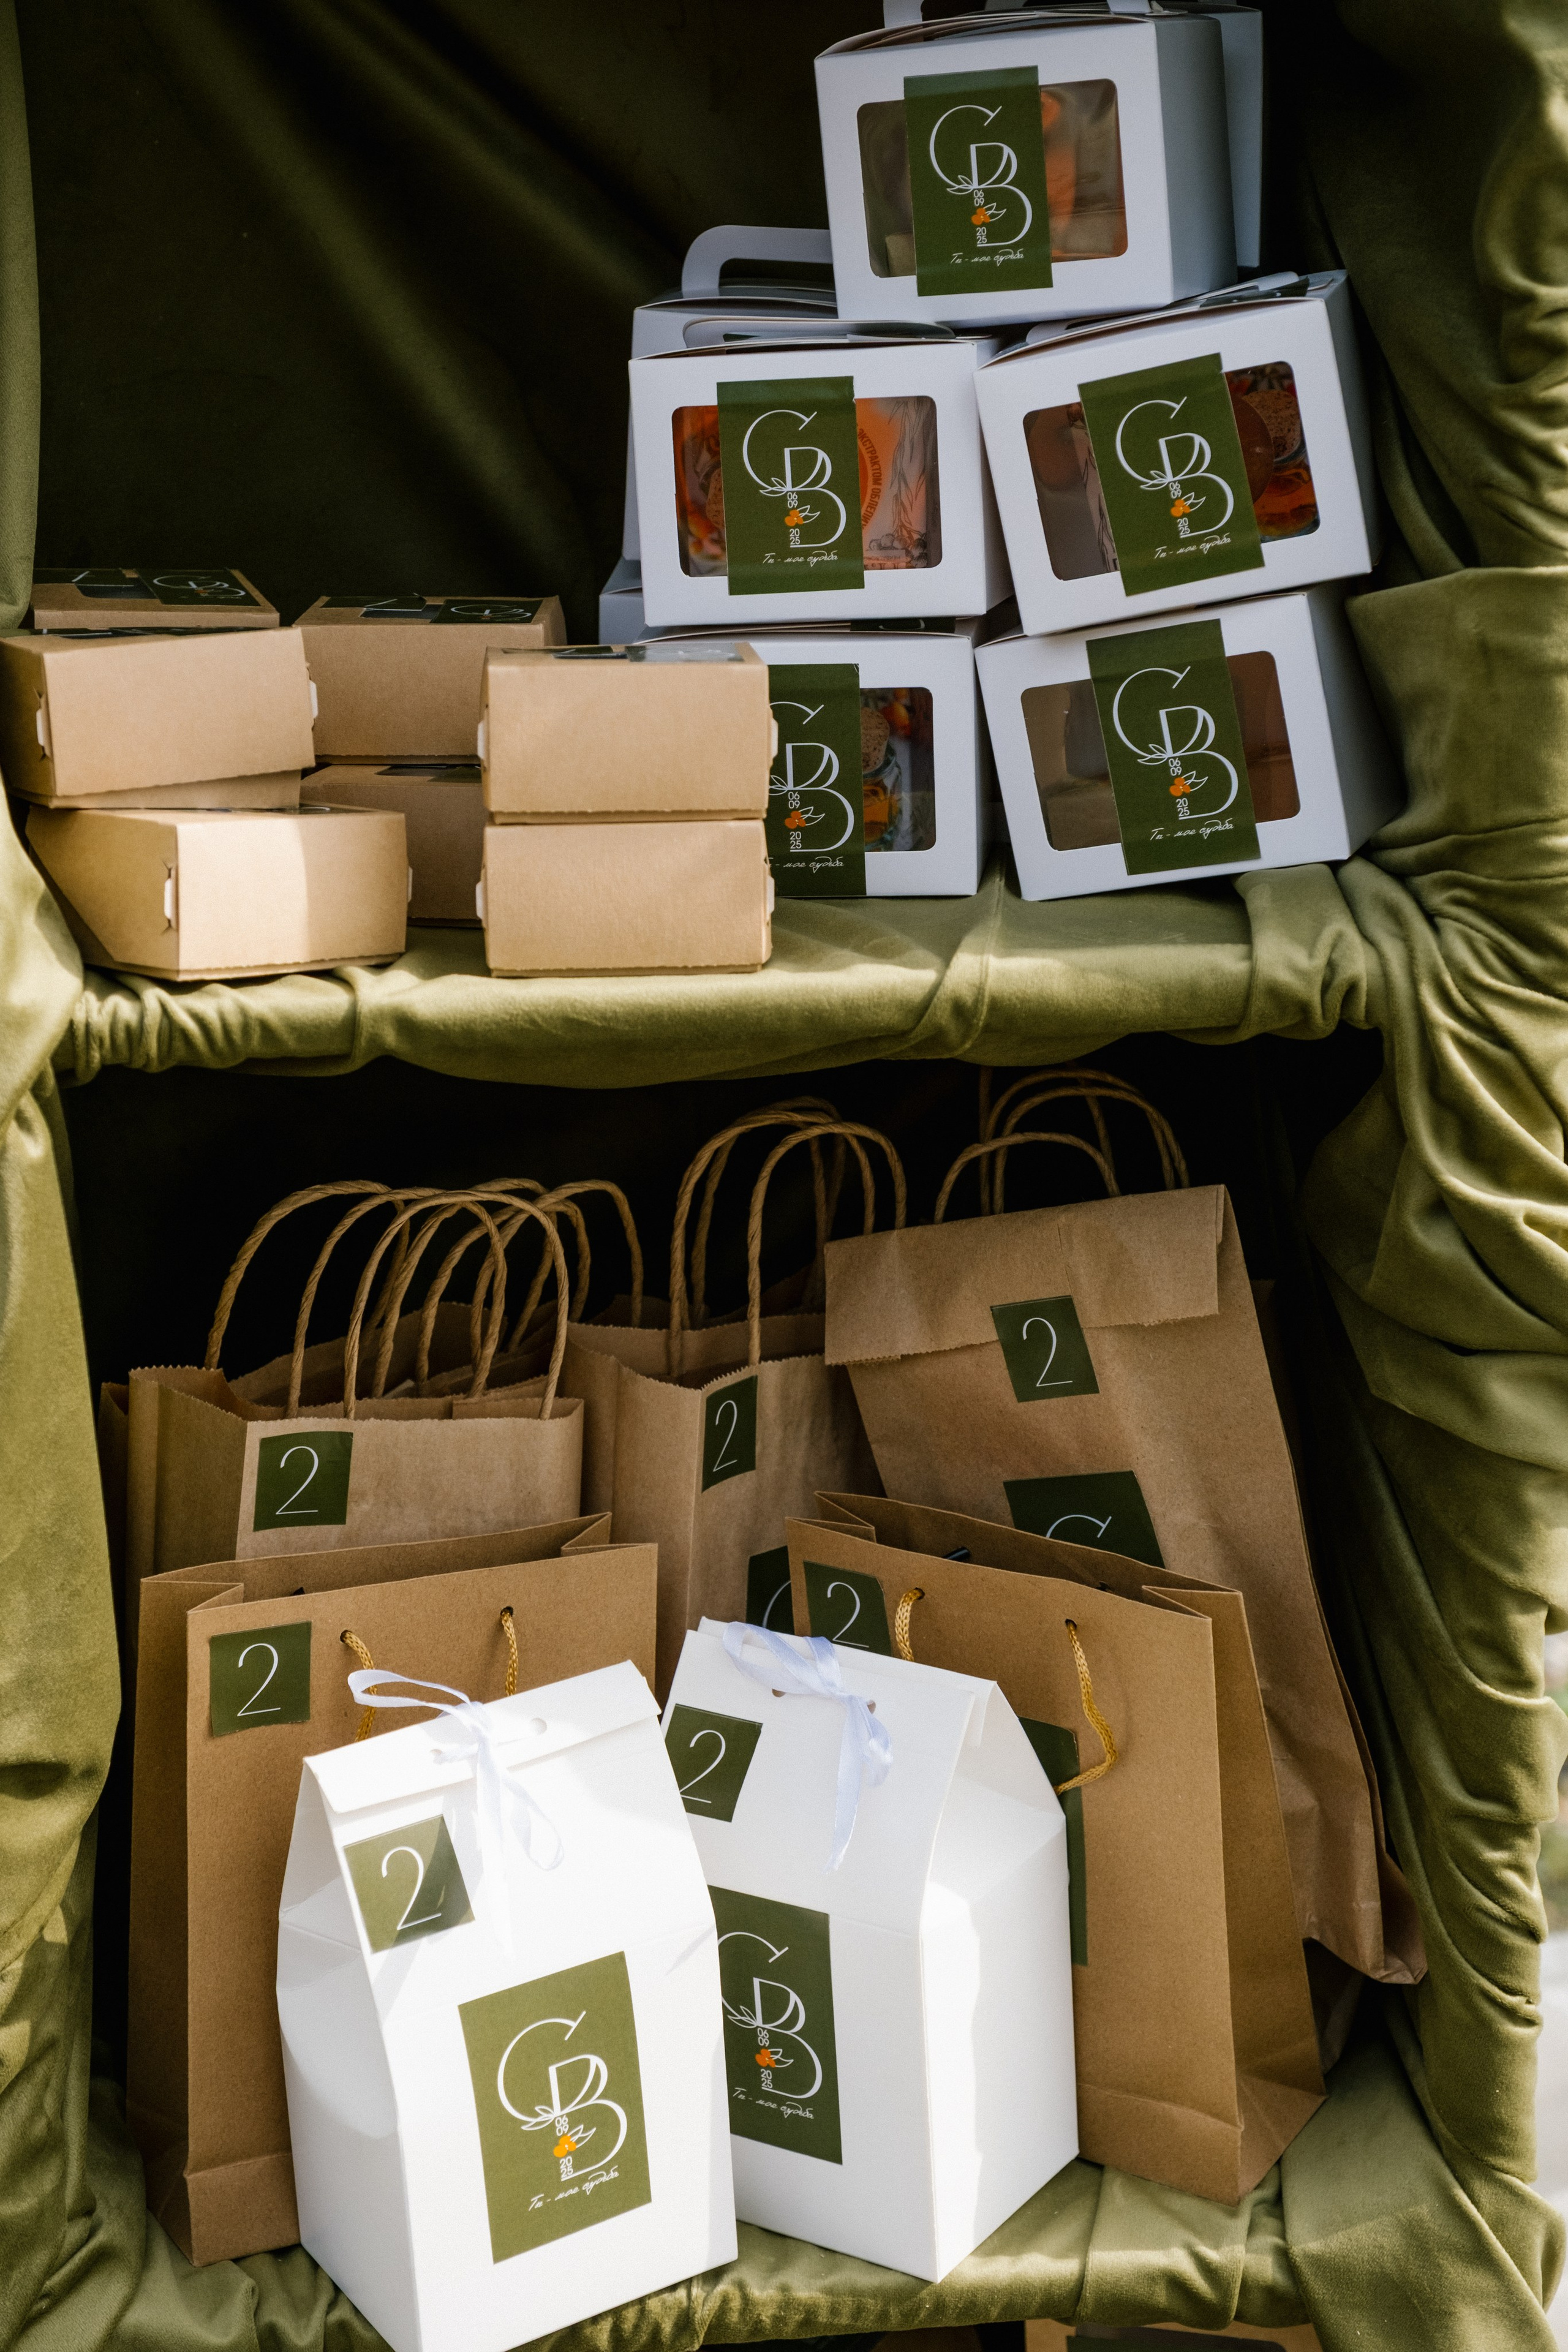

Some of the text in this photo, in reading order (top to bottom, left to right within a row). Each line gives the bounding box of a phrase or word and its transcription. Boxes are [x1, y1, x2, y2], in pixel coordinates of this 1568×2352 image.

[993, 249, 1024, 266] судьба
[1169, 481, 1180, 490] 06
[787, 492, 797, 500] 06
[1170, 489, 1182, 499] 09
[862, 488, 881, 529] ОБЛЕПИ
[1177, 518, 1188, 527] 20
[1179, 526, 1190, 535] 25
[1199, 532, 1231, 554] судьба
[807, 550, 839, 567] судьба
[1169, 758, 1181, 767] 06
[1170, 766, 1182, 776] 09
[788, 791, 800, 800] 06
[789, 800, 800, 809] 09
[1176, 797, 1188, 808] 20
[1177, 807, 1189, 817] 25
[1199, 818, 1234, 840] судьба
[790, 831, 801, 840] 20
[790, 840, 802, 849] 25
[809, 856, 845, 873] судьба
[1022, 1317, 1073, 1387] 2
[712, 1400, 737, 1473] 2
[275, 1445, 319, 1515] 2
[826, 1581, 869, 1648] 2
[237, 1643, 281, 1717] 2
[679, 1729, 726, 1804] 2
[381, 1846, 442, 1931] 2
[758, 2028, 769, 2038] 06
[758, 2037, 769, 2047] 09
[761, 2069, 772, 2079] 20
[761, 2078, 772, 2088] 25
[780, 2101, 814, 2119] судьба
[555, 2114, 568, 2127] 06
[556, 2124, 568, 2136] 09
[560, 2156, 573, 2169] 20
[561, 2166, 573, 2179] 25
[582, 2165, 619, 2195] судьба
